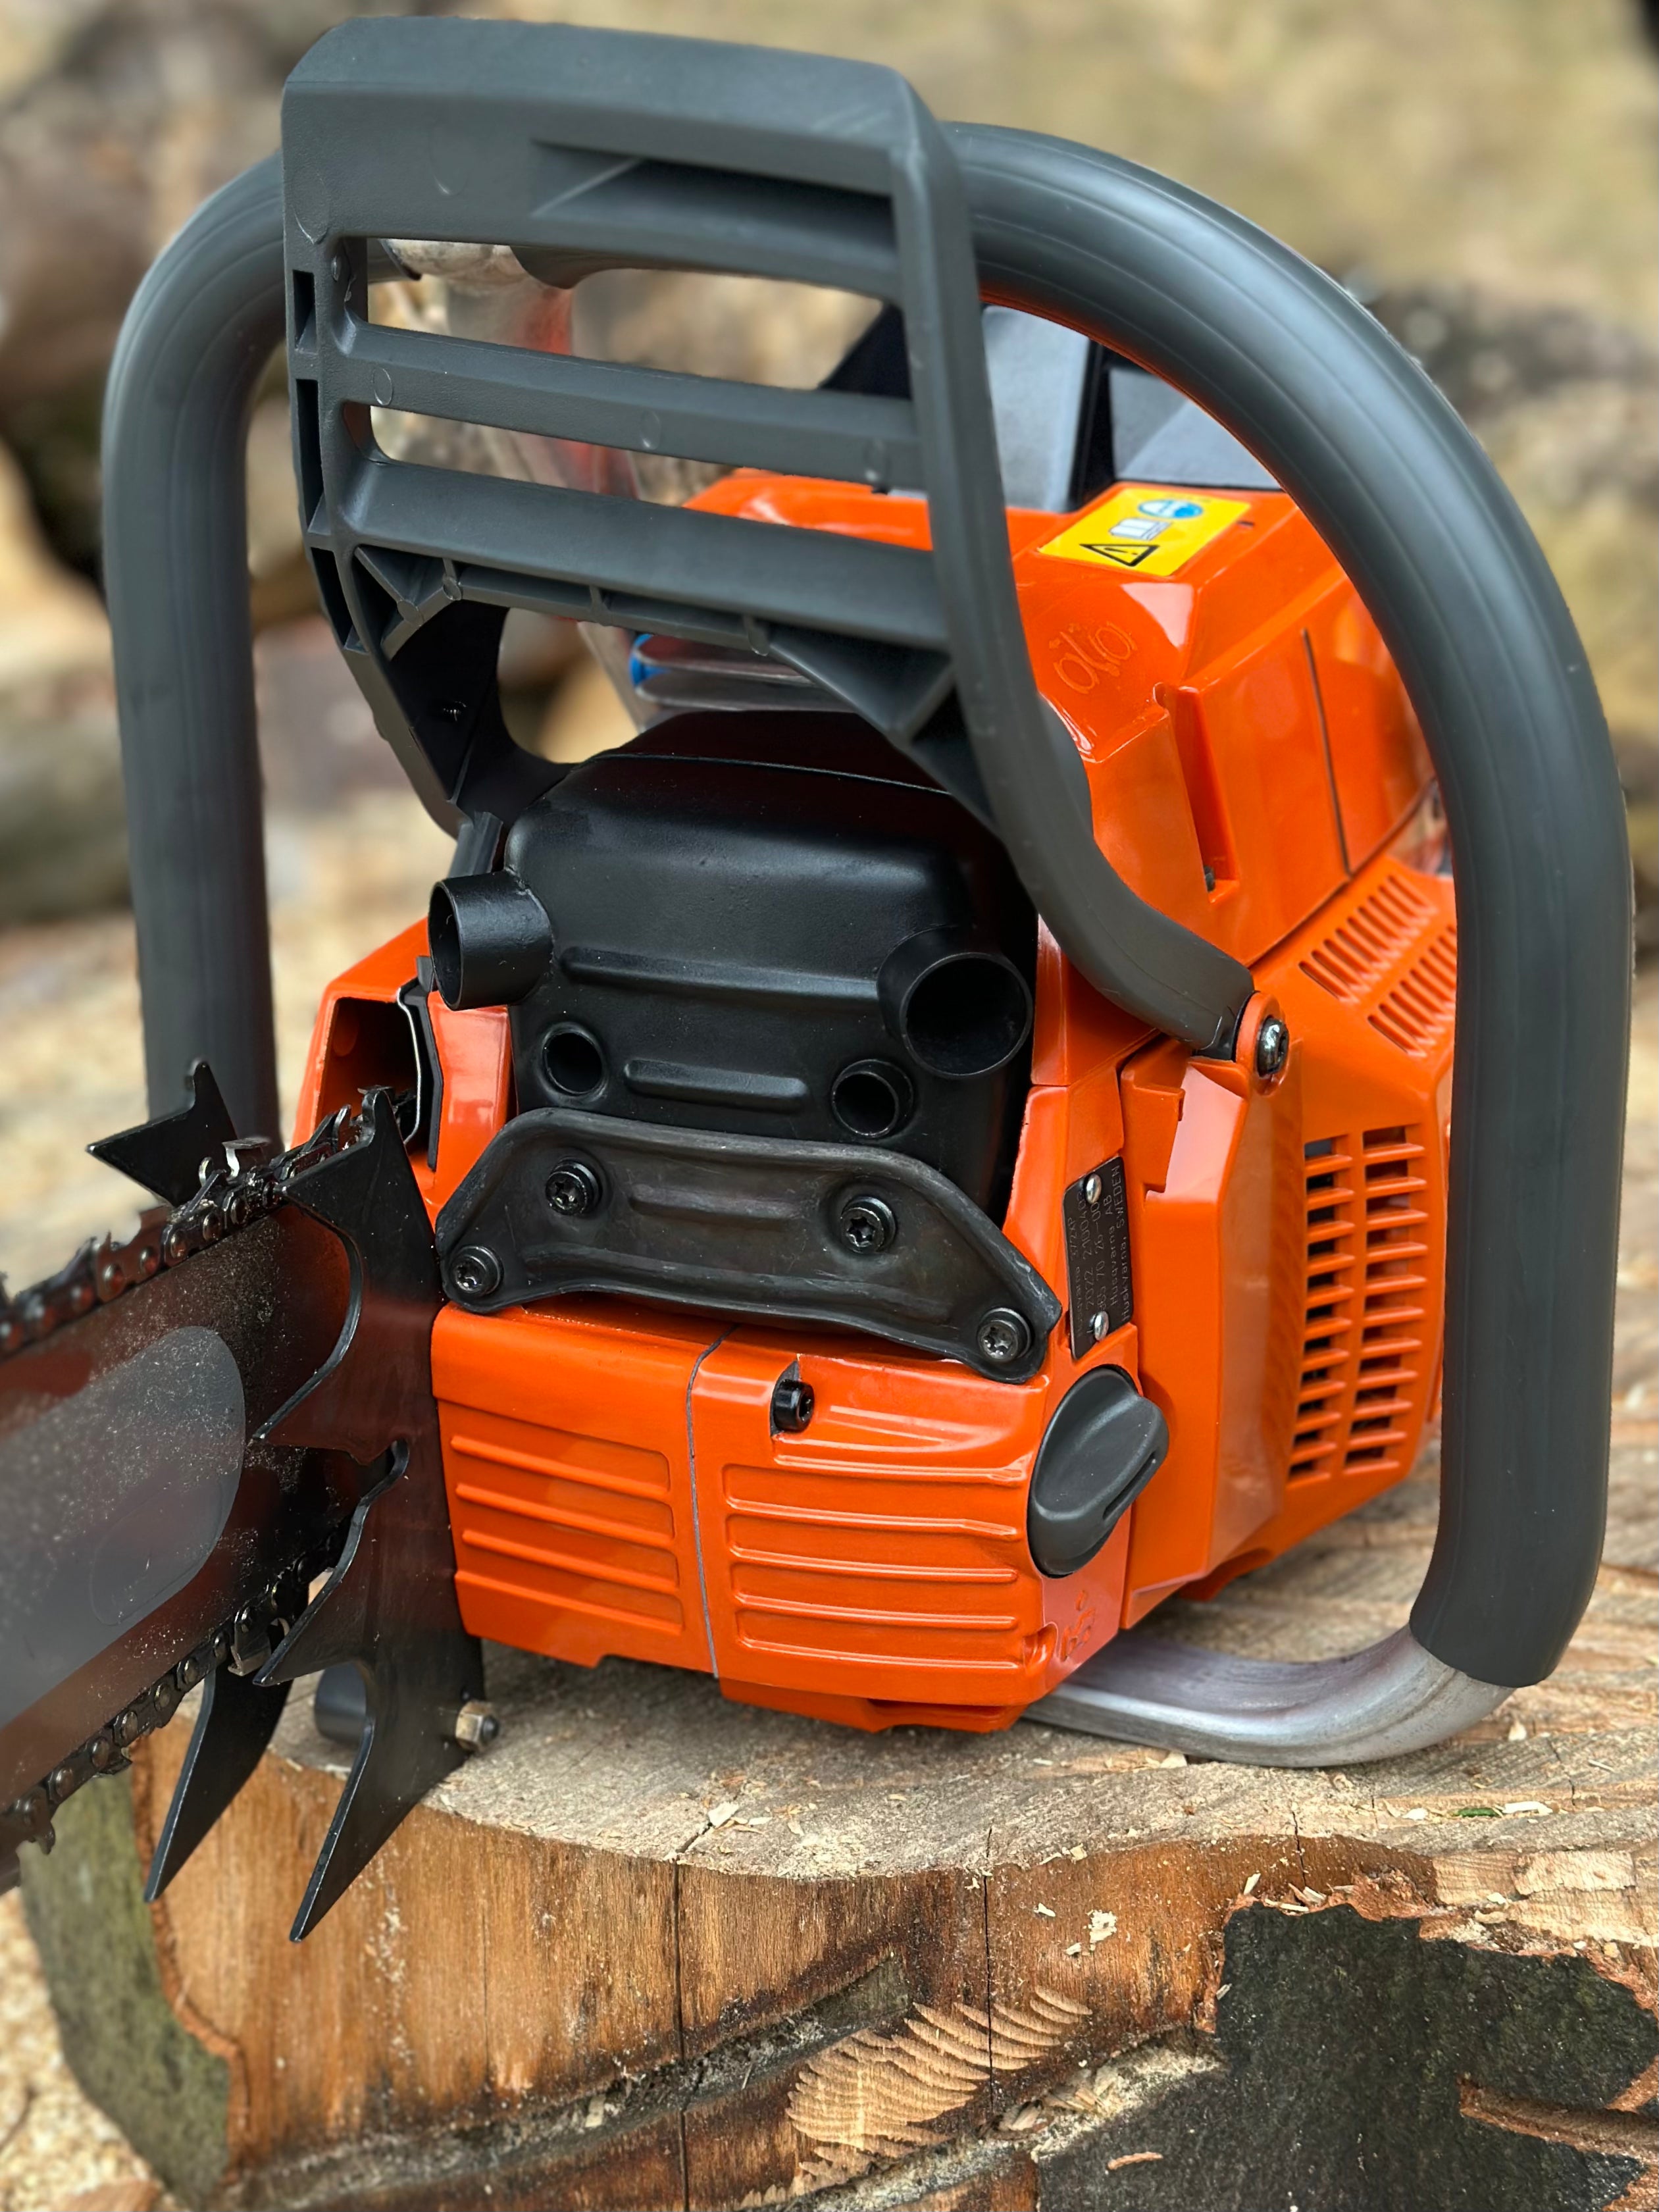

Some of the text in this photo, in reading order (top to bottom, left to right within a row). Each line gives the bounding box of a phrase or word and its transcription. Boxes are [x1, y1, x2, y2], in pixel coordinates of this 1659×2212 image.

[1111, 1165, 1125, 1228] SWEDEN
[1103, 1195, 1118, 1306] Husqvarna AB
[1084, 1267, 1094, 1310] 2022
